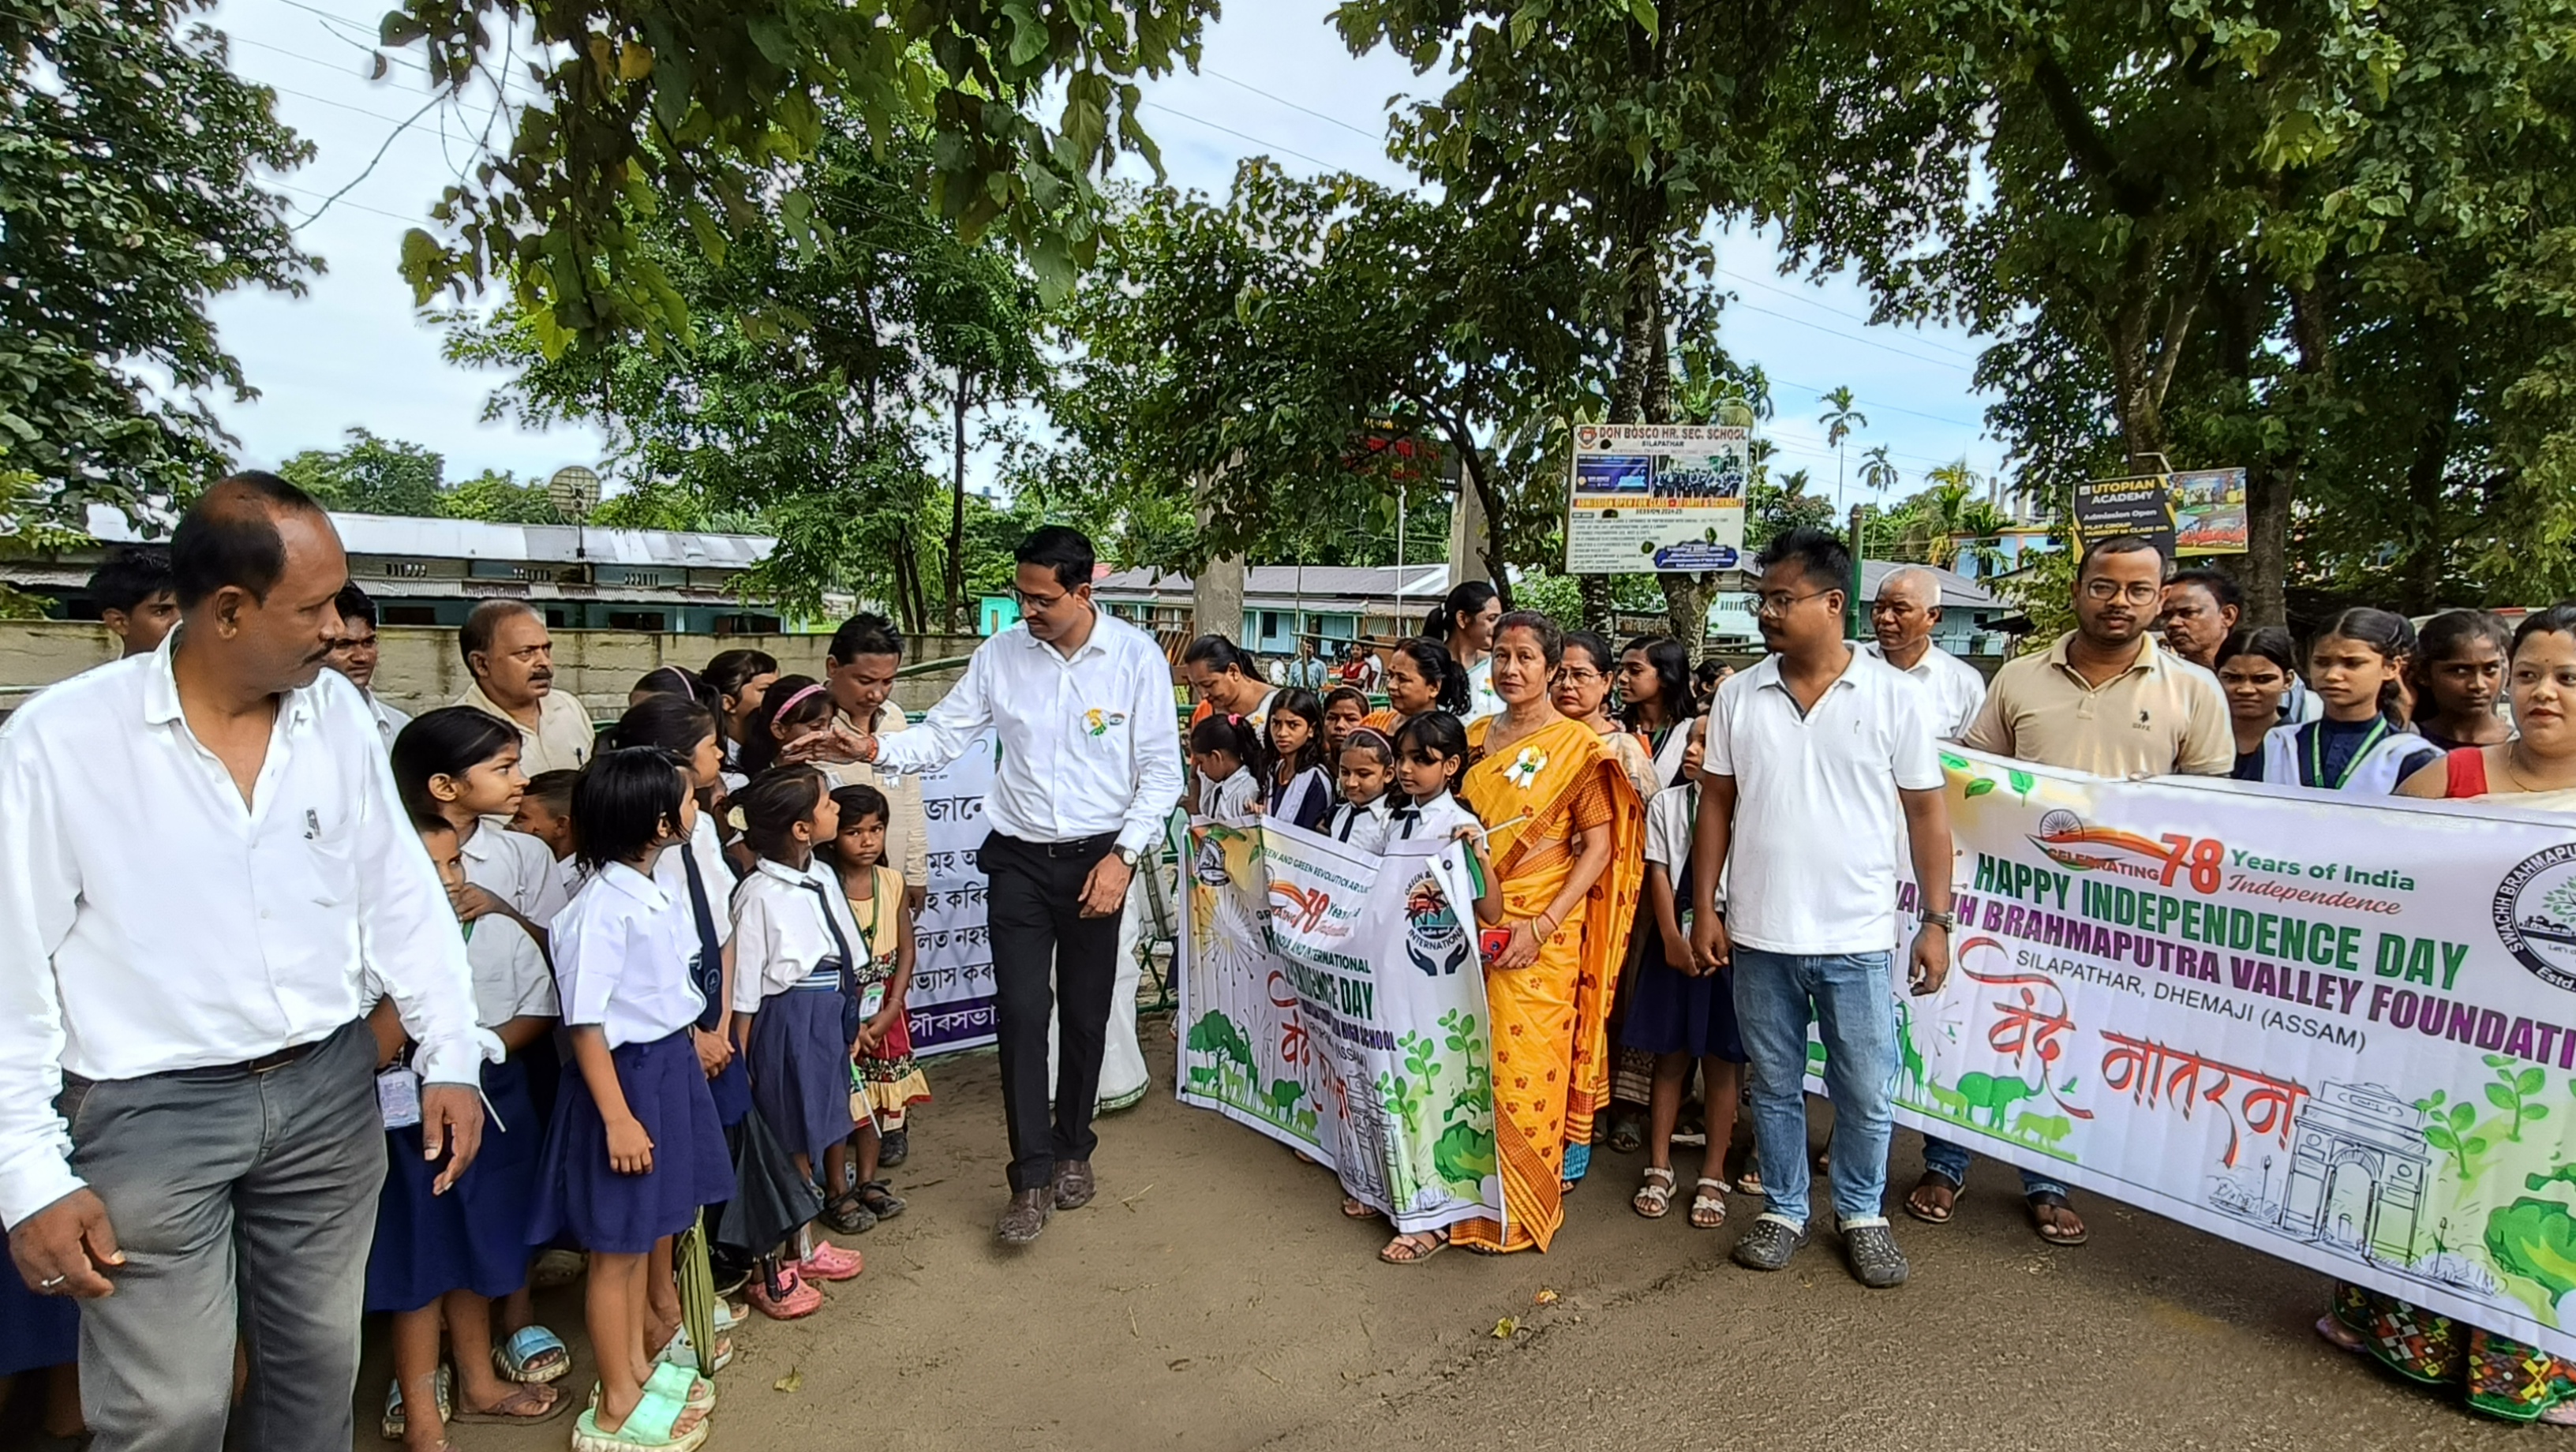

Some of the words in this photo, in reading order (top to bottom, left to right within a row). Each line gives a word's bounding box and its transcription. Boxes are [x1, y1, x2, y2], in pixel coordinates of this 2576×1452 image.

[1600, 427, 1621, 439] DON
[1624, 427, 1657, 440] BOSCO
[1661, 428, 1679, 440] HR.
[1682, 428, 1703, 440] SEC.
[1707, 428, 1747, 440] SCHOOL
[2091, 479, 2155, 494] UTOPIAN
[2091, 491, 2155, 505] ACADEMY
[2084, 511, 2130, 521] Admission
[2132, 509, 2157, 518] Open
[1278, 851, 1294, 865] AND
[1293, 859, 1313, 874] GREEN
[2046, 847, 2160, 881] CELEBRATING
[2159, 833, 2225, 894] 78
[2230, 848, 2301, 877] Years
[2308, 863, 2338, 881] of
[2343, 865, 2416, 891] India
[2226, 874, 2402, 915] Independence
[1974, 851, 2071, 911] HAPPY
[2081, 878, 2362, 972] INDEPENDENCE
[2374, 931, 2469, 991] DAY
[2494, 896, 2524, 953] SWACHH
[1982, 900, 2221, 985] BRAHMAPUTRA
[2230, 955, 2364, 1016] VALLEY
[1339, 975, 1373, 1021] DAY
[2016, 949, 2146, 998] SILAPATHAR,
[2154, 982, 2255, 1023] DHEMAJI
[2260, 1008, 2367, 1054] (ASSAM)
